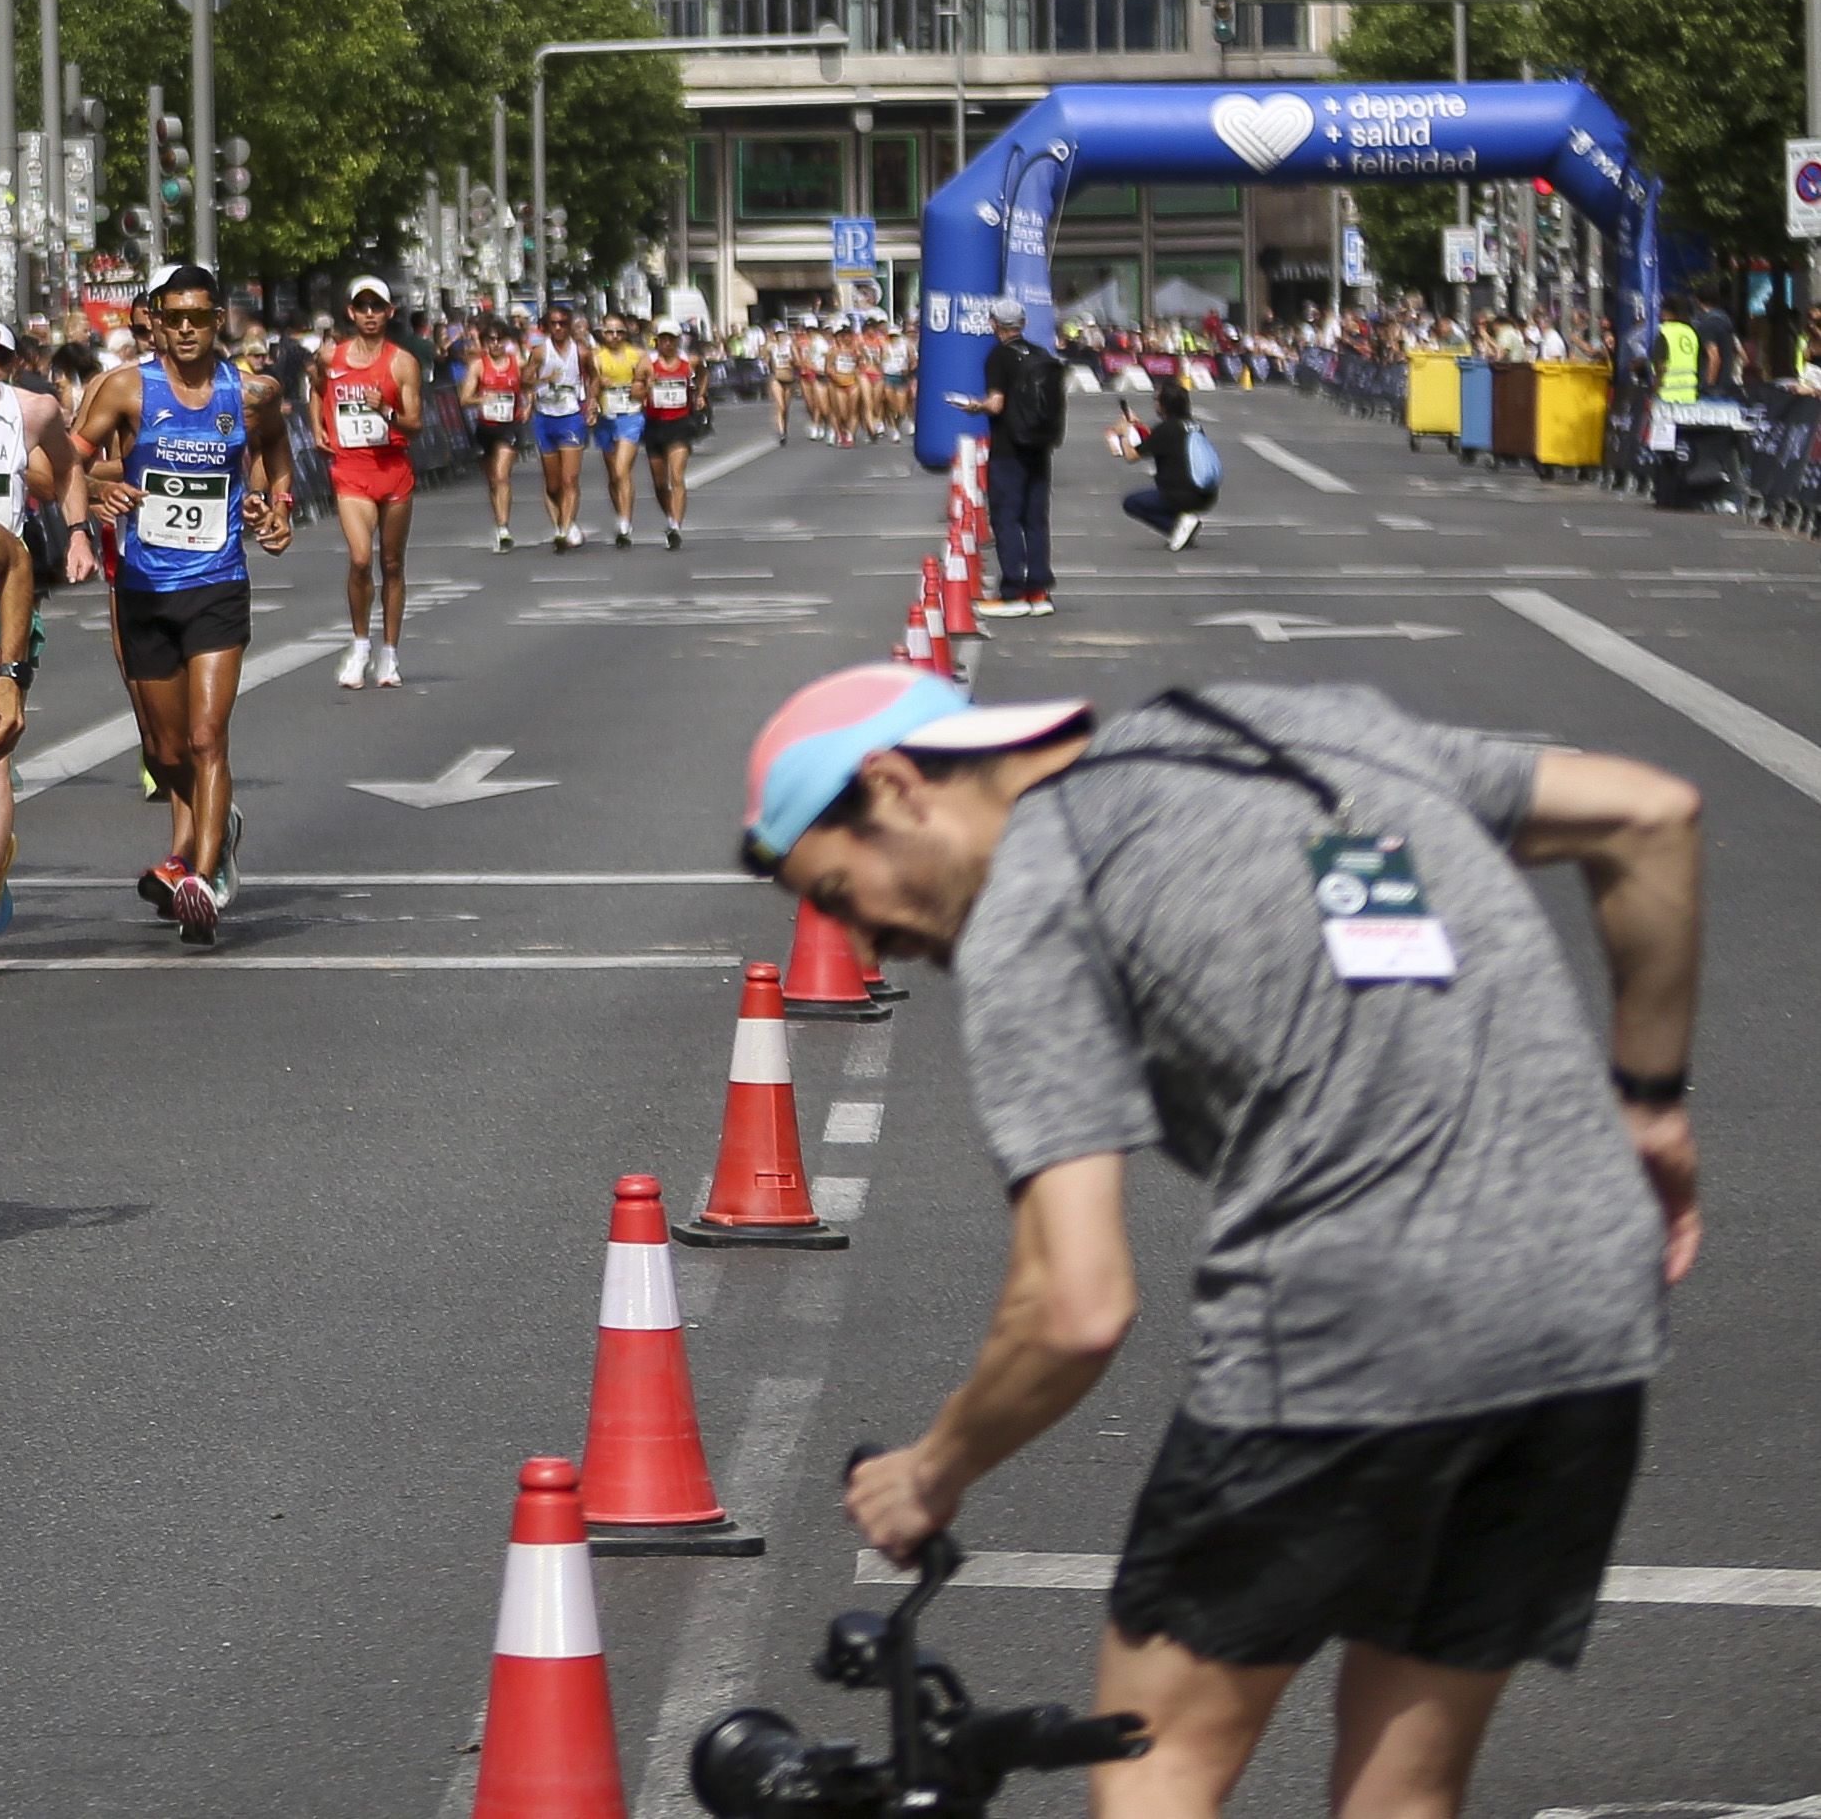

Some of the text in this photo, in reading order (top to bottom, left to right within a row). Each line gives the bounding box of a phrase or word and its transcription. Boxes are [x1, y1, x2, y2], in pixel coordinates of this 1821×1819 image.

[1349, 91, 1467, 123] deporte
[1349, 118, 1431, 148] salud
[1349, 145, 1477, 174] felicidad
[351, 419, 373, 436] 13
[155, 448, 226, 465] MEXICANO
[157, 436, 227, 453] EJERCITO
[164, 504, 203, 530] 29
